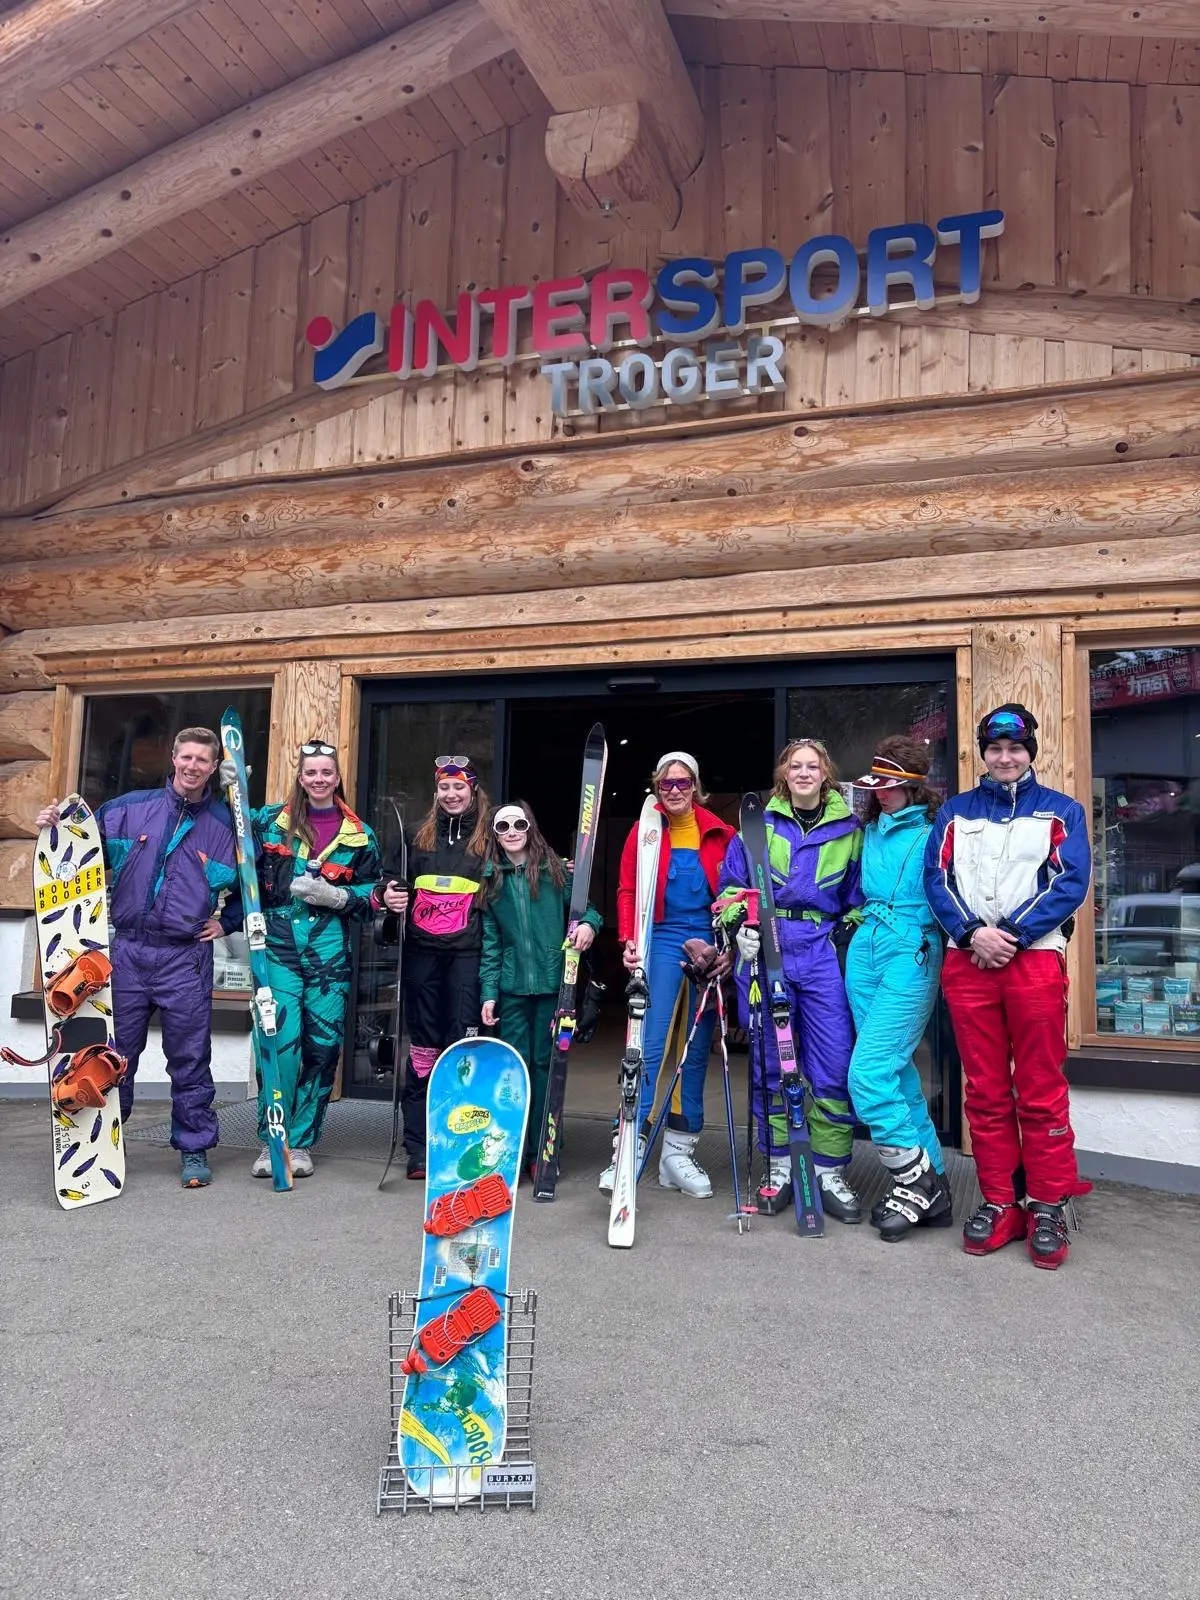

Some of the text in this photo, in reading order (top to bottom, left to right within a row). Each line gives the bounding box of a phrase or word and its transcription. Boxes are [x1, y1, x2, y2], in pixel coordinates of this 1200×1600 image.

[388, 210, 1005, 378] INTERSPORT
[541, 336, 786, 417] TROGER
[581, 784, 596, 835] TYROLIA
[39, 877, 102, 909] BOOGER
